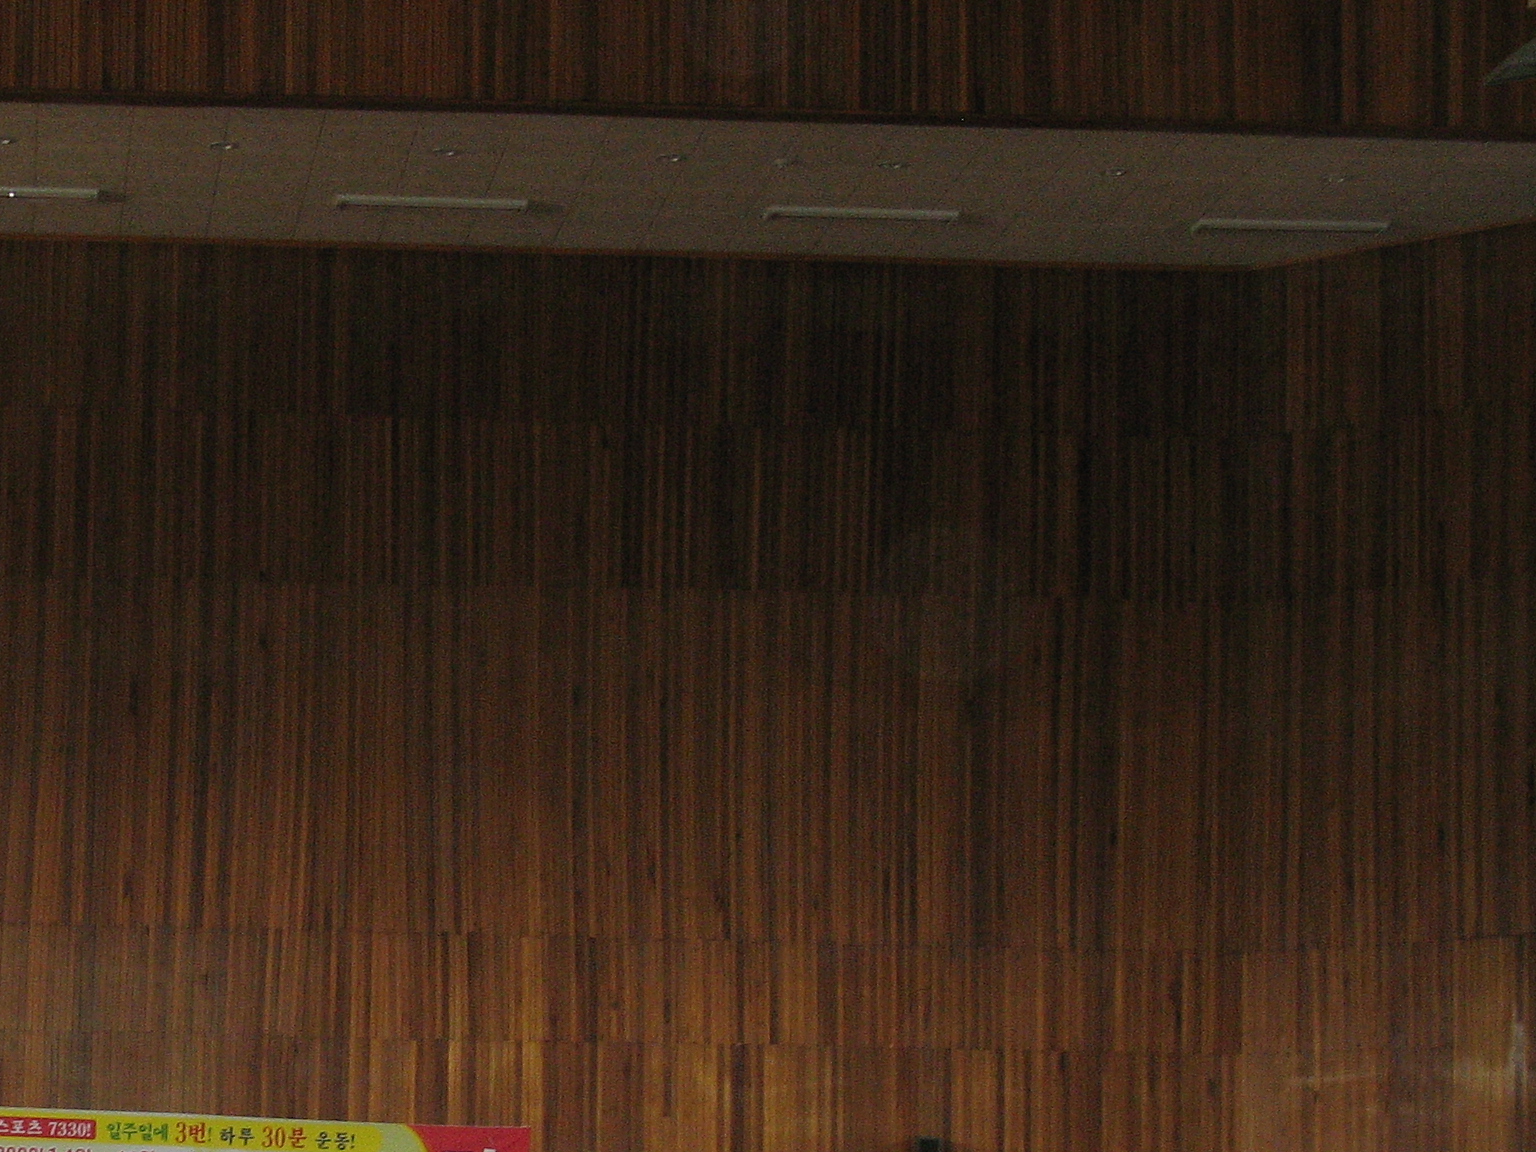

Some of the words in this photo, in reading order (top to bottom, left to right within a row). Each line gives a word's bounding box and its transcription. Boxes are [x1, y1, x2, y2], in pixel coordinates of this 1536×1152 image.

[48, 1123, 91, 1138] 7330!
[106, 1122, 168, 1142] 일주일에
[175, 1121, 212, 1143] 3번!
[219, 1128, 255, 1145] 하루
[262, 1126, 307, 1148] 30분
[315, 1131, 356, 1150] 운동!
